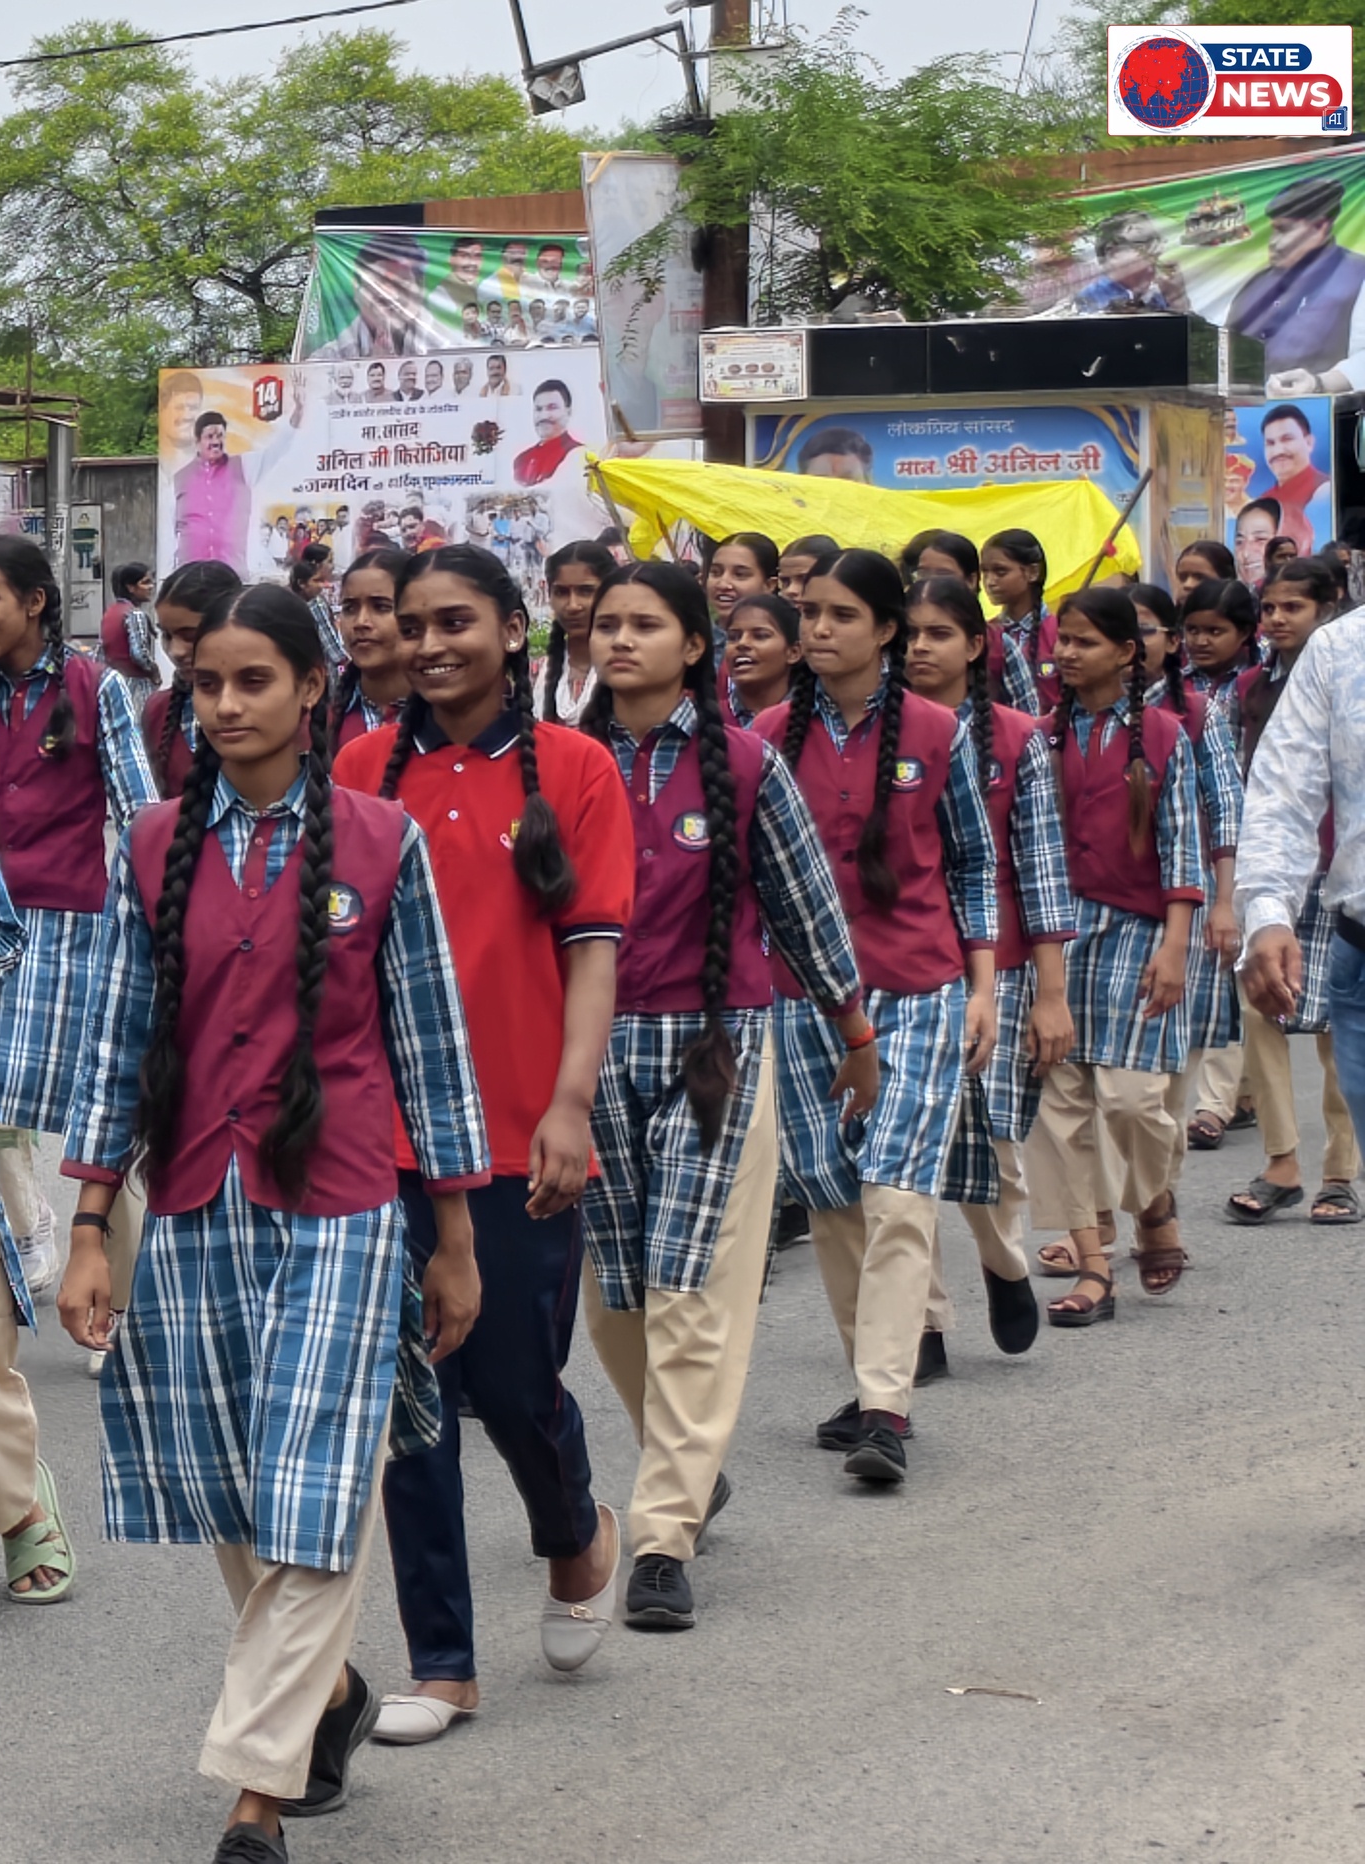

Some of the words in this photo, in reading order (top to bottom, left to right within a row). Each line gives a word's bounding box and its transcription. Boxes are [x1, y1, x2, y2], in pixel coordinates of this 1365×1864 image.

[255, 381, 278, 406] 14
[887, 418, 960, 438] लोकप्रिय
[963, 417, 1015, 434] सांसद
[316, 449, 363, 471] अनिल
[369, 446, 389, 468] जी
[393, 441, 467, 467] फिरोजिया
[947, 446, 979, 474] श्री
[984, 445, 1061, 473] अनिल
[1067, 444, 1102, 471] जी
[303, 472, 372, 493] जन्मदिन
